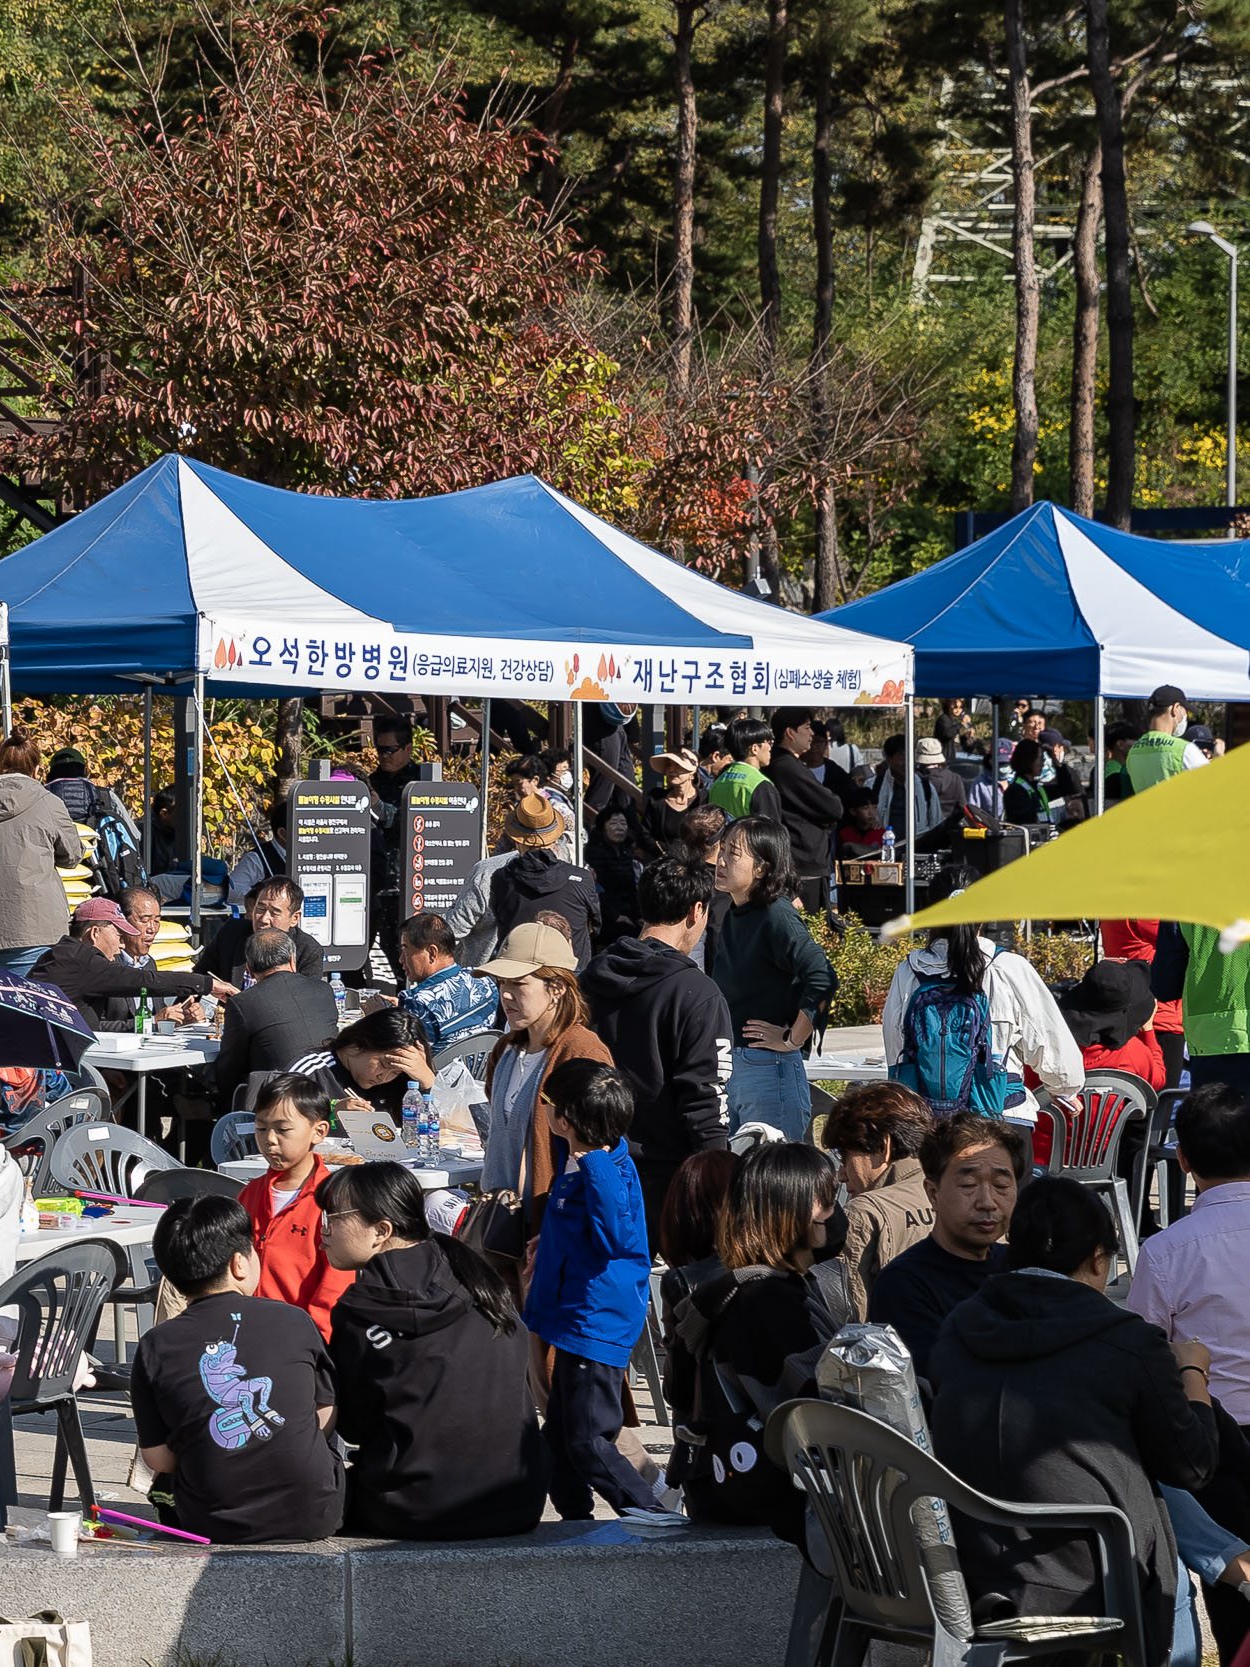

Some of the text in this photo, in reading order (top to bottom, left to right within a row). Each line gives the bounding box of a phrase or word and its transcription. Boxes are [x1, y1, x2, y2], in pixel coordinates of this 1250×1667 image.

[248, 636, 555, 683] 오석한방병원 (응급의료지원, 건강상담)
[633, 658, 862, 696] 재난구조협회 (심폐소생술 체험)
